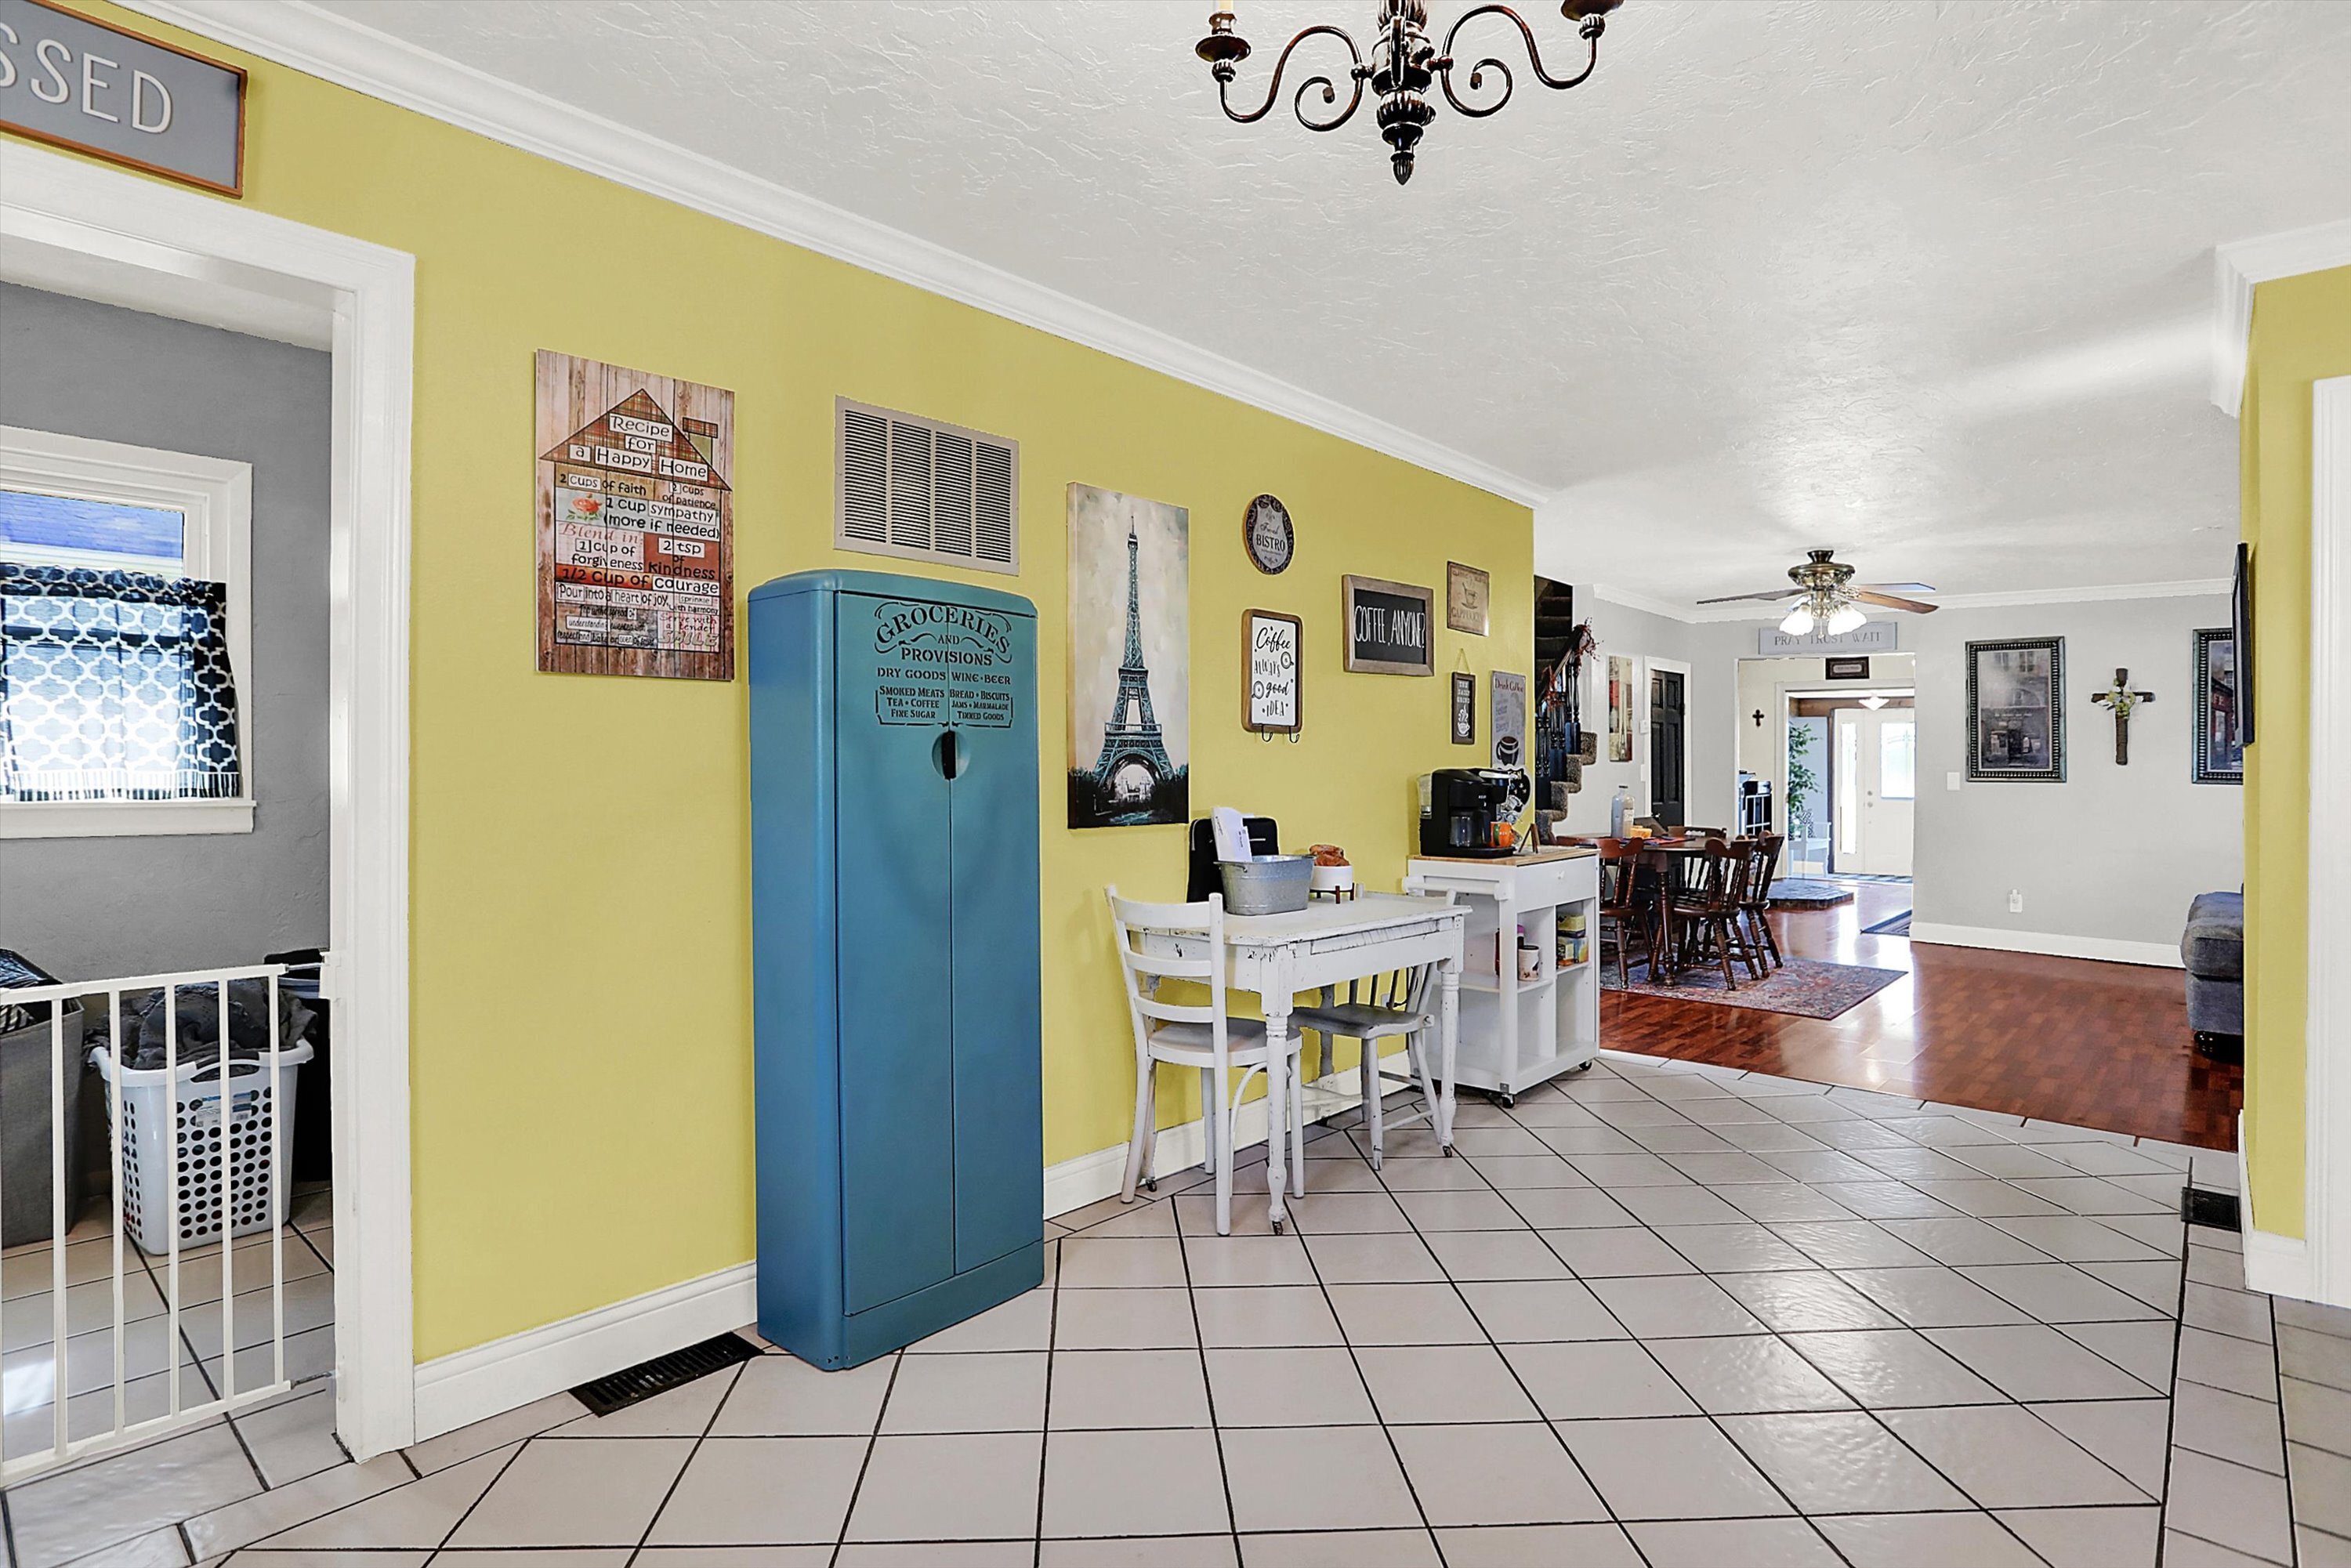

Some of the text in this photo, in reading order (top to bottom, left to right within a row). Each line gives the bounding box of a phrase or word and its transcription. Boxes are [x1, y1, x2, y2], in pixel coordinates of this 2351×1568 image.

[610, 416, 669, 437] Recipe
[628, 437, 654, 452] for
[576, 445, 707, 478] a Happy Home
[560, 474, 647, 496] 2 cups of faith
[672, 483, 704, 496] 2 cups
[606, 497, 714, 523] 1 cup sympathy
[662, 494, 716, 510] of patience
[559, 523, 614, 541] Blend
[603, 513, 719, 539] (more if needed)
[579, 541, 636, 556] 1 cup of
[663, 540, 701, 555] 2 tsp
[1255, 534, 1285, 552] BISTRO
[571, 553, 643, 570] forgiveness
[673, 555, 686, 564] of
[563, 567, 586, 580] 1/2
[630, 575, 650, 588] of
[654, 578, 719, 594] courage
[559, 583, 582, 598] Pour
[585, 586, 603, 599] into
[614, 589, 639, 603] heart
[641, 593, 651, 605] of
[680, 596, 710, 605] sprinkle
[687, 606, 719, 615] harmony
[876, 606, 1010, 654] GROCERIES
[1391, 610, 1425, 648] ANYONE?
[658, 630, 720, 646] SMILE
[937, 634, 960, 645] AND
[1256, 626, 1291, 653] Coffee
[901, 647, 992, 666] PROVISIONS
[877, 667, 946, 681] DRY GOODS
[1254, 658, 1281, 677] ALWAYS
[1266, 682, 1289, 698] good
[1266, 700, 1284, 716] IDEA
